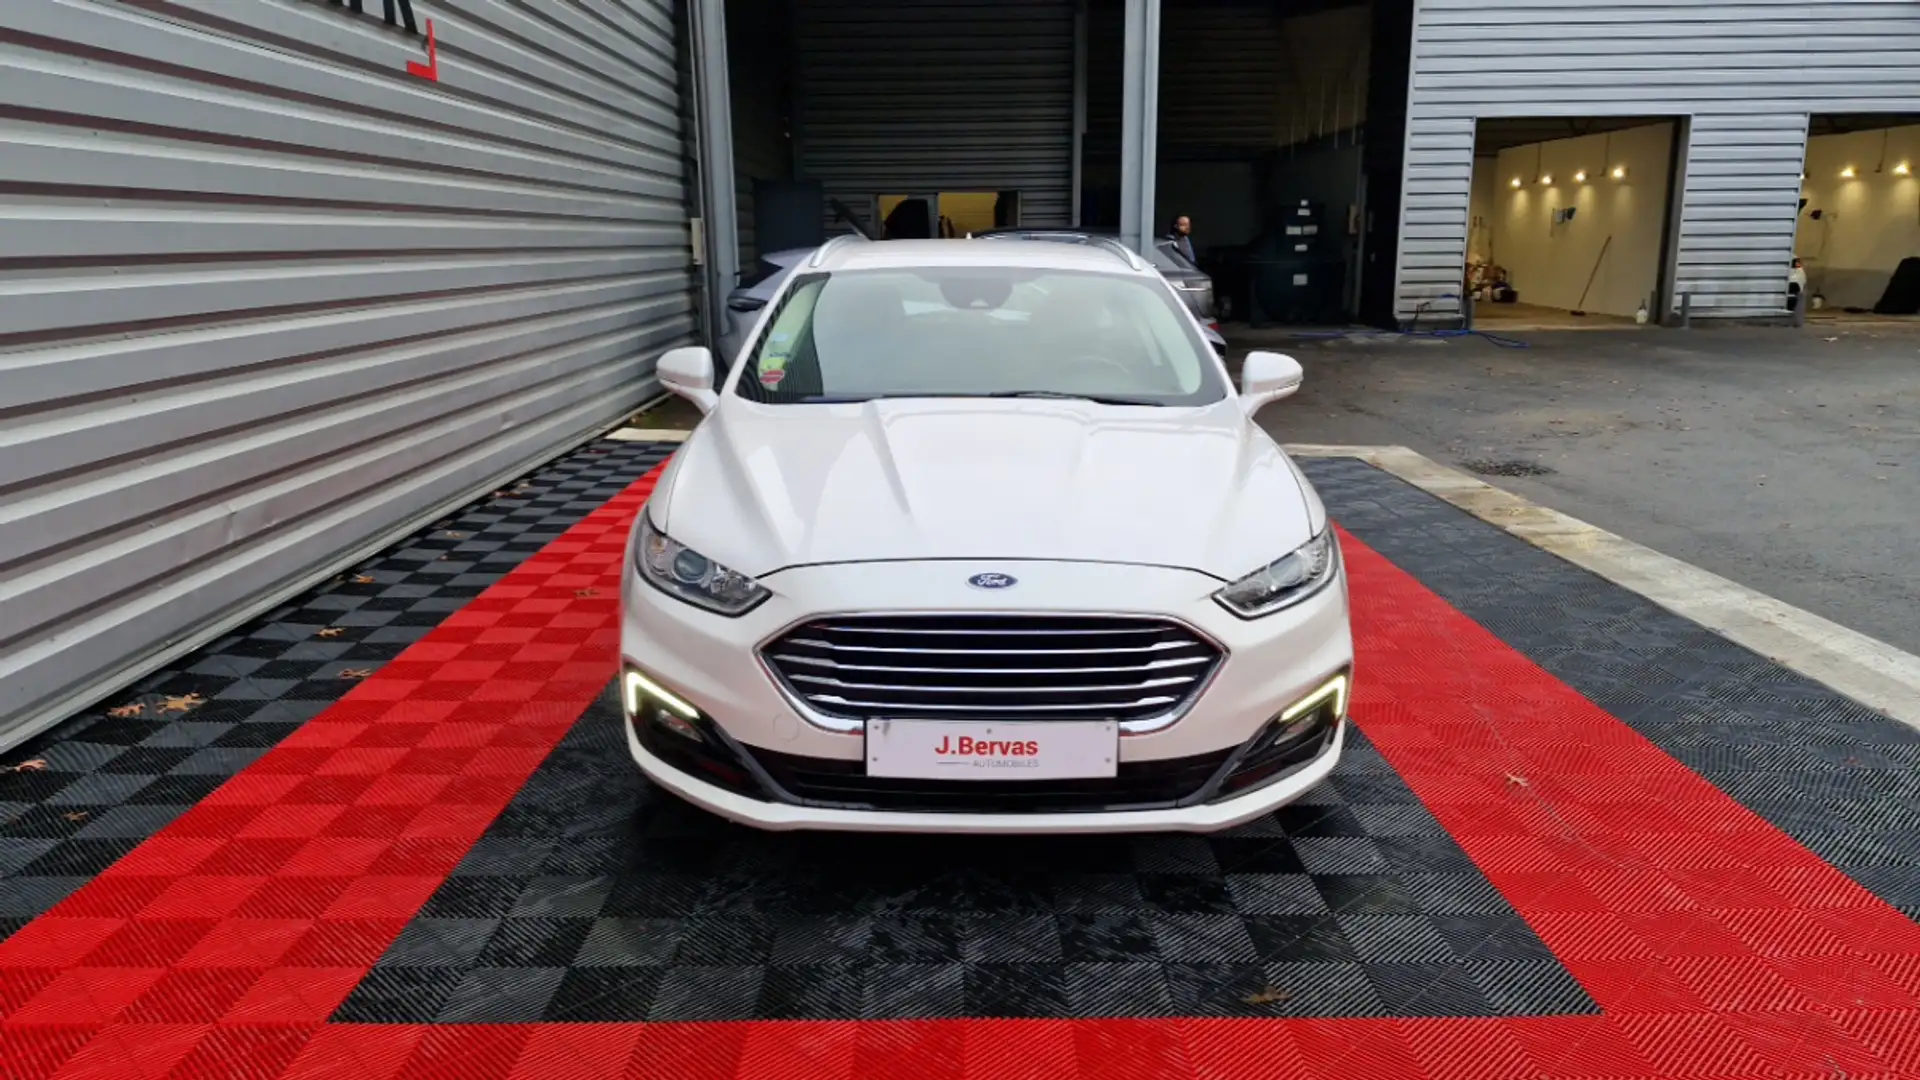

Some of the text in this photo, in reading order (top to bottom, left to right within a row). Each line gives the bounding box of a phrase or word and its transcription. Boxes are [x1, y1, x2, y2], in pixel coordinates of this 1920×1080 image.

[975, 573, 1010, 586] Ford
[935, 735, 1039, 755] J.Bervas
[973, 759, 1039, 768] AUTOMOBILES
